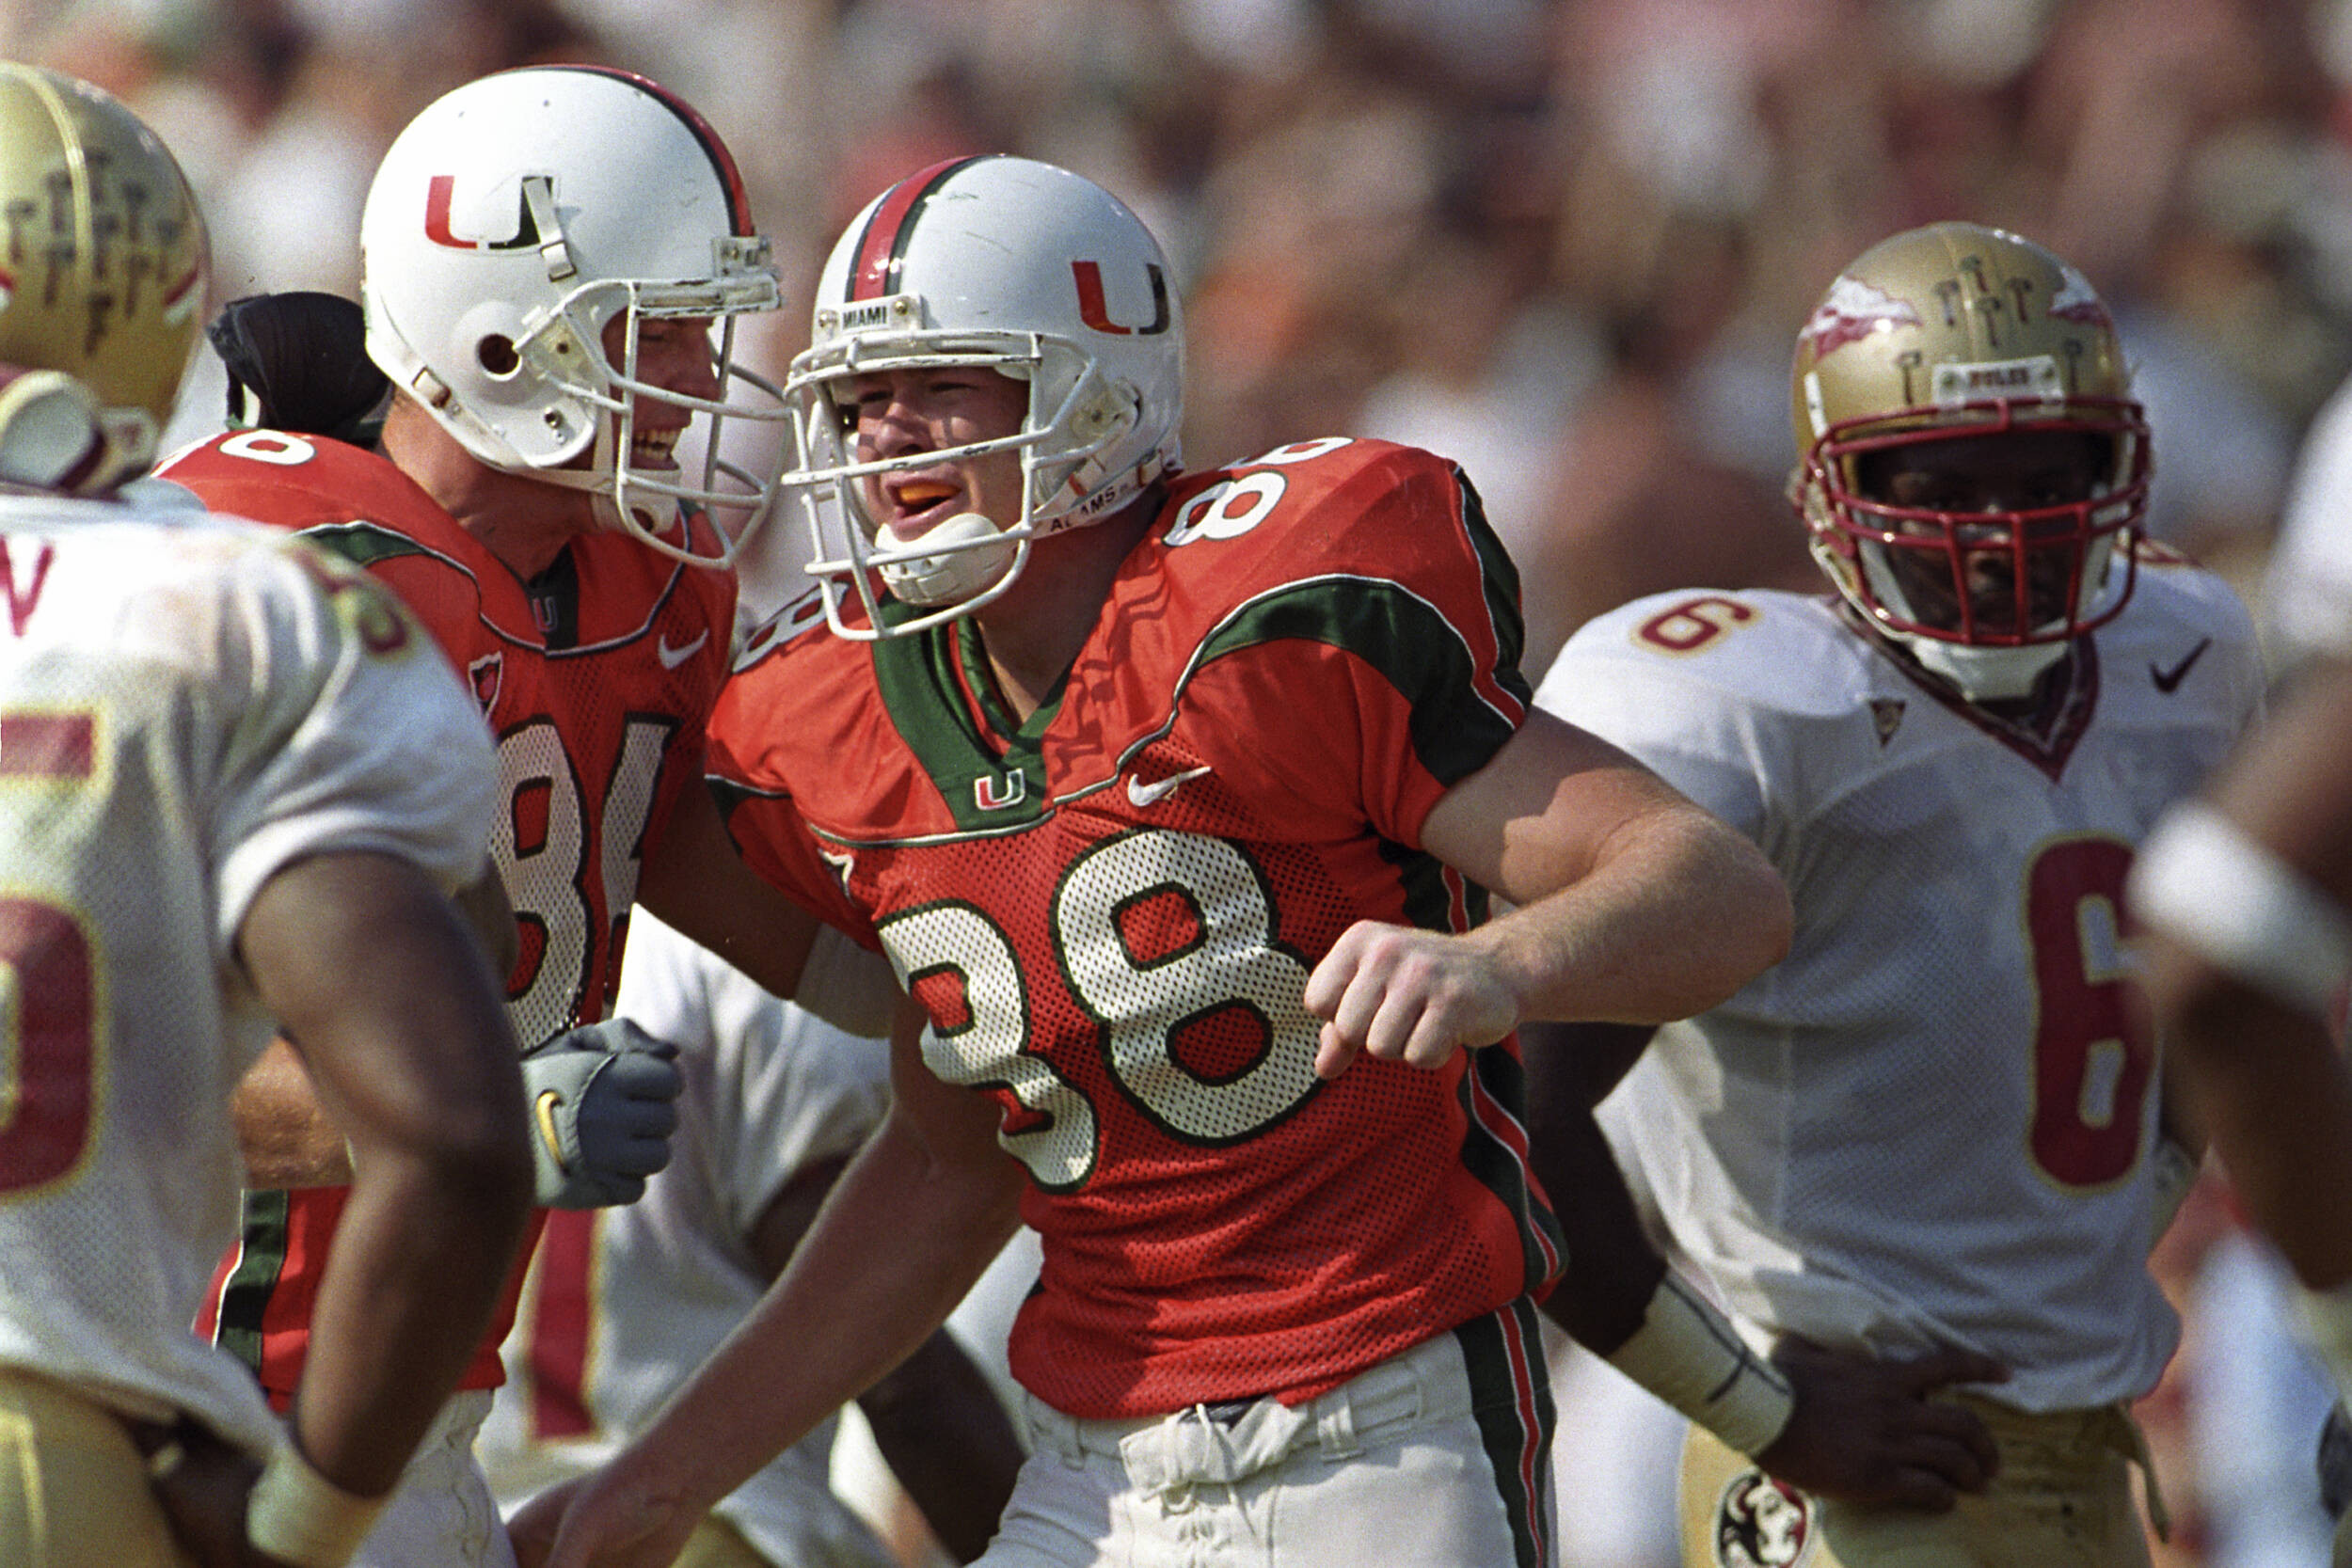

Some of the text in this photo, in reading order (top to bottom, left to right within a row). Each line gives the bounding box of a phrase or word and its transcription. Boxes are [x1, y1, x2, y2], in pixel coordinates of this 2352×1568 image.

[425, 175, 553, 249] U
[843, 306, 887, 328] MIAMI
[1071, 261, 1170, 335] U
[1630, 595, 1762, 657] 6
[974, 768, 1026, 811] U
[2021, 832, 2156, 1196] 6
